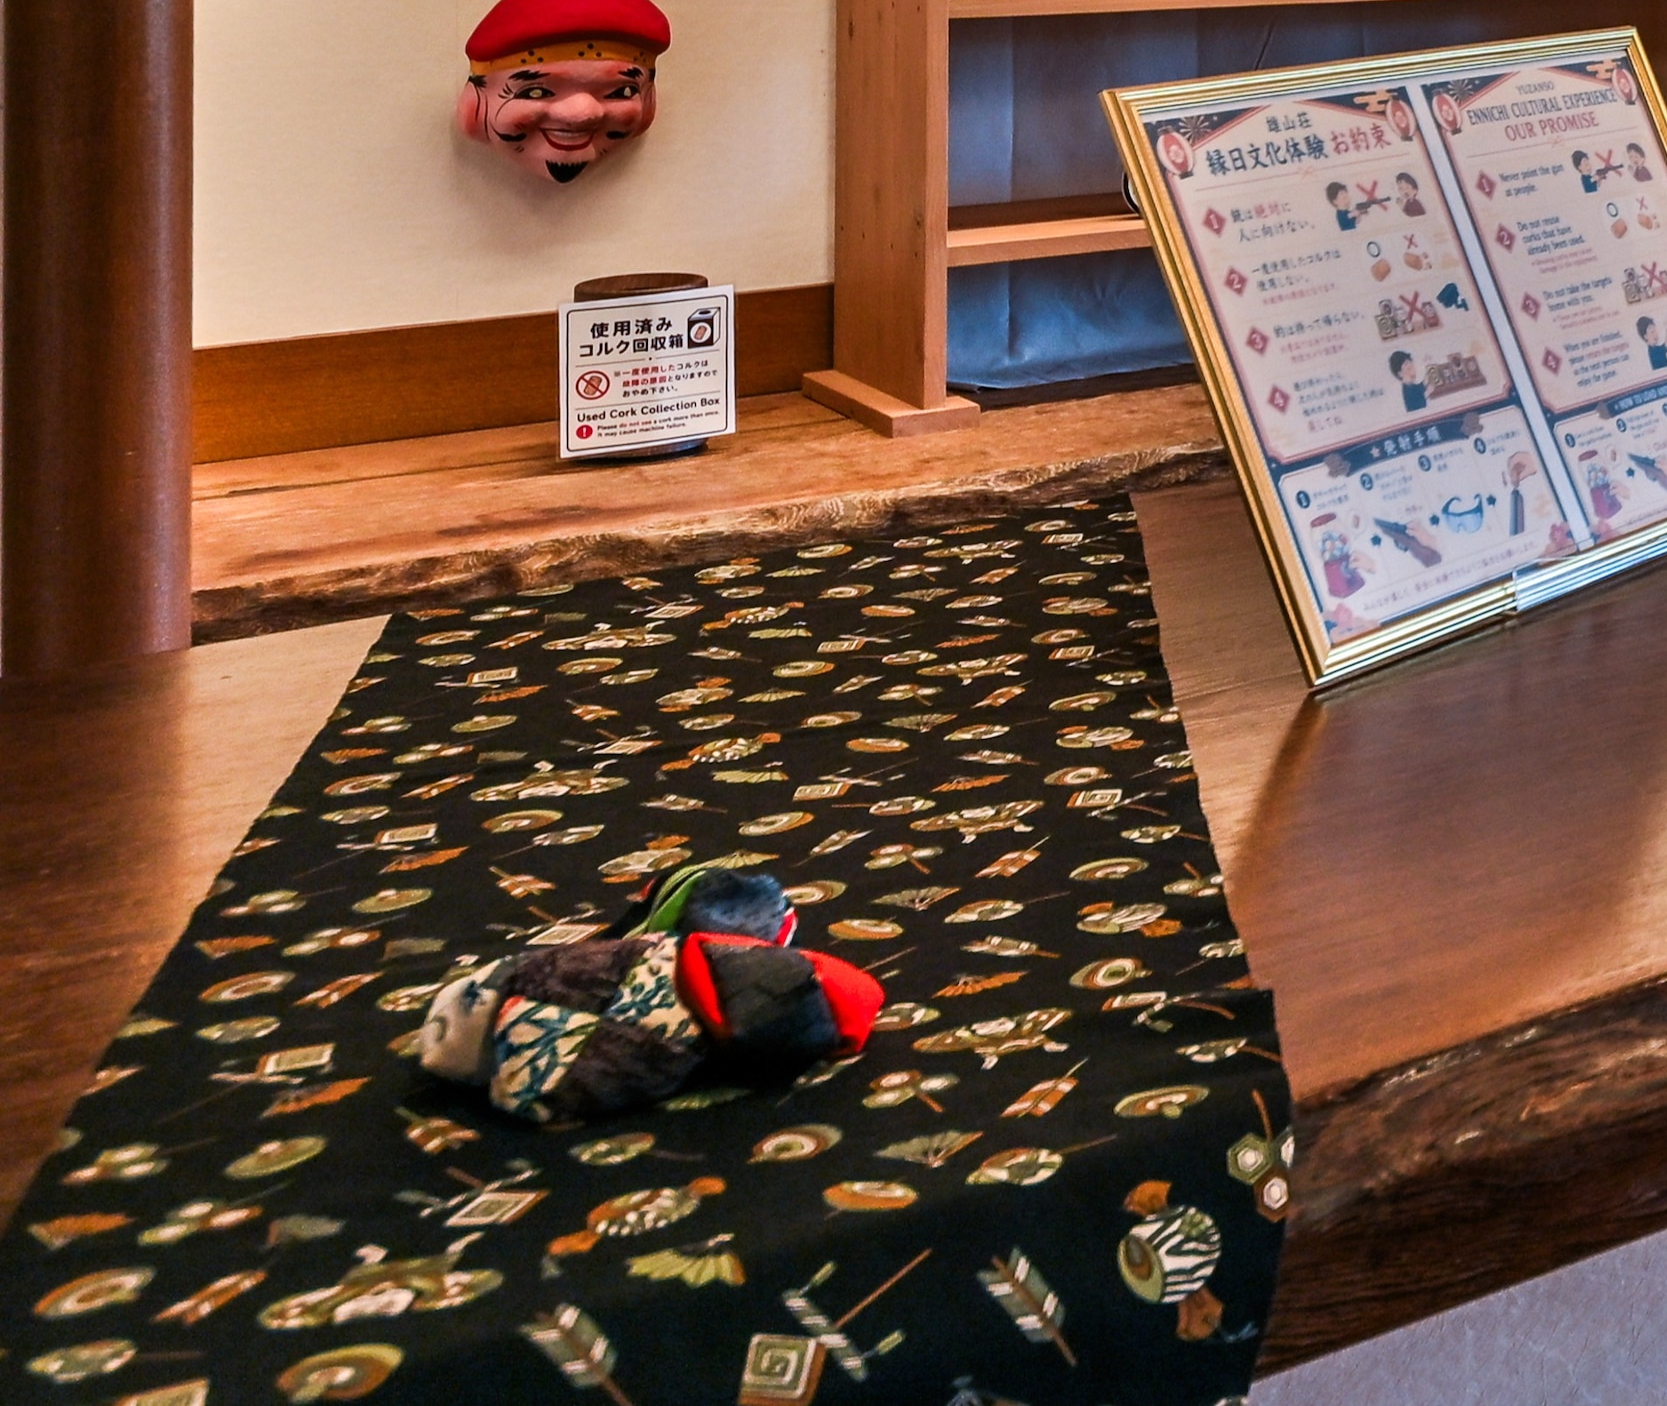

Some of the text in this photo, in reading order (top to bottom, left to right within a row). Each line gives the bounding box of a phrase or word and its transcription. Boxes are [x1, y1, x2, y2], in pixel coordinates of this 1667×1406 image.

[1466, 87, 1618, 127] ENNICHI CULTURAL EXPERIENCE
[1265, 111, 1313, 134] 雄山荘
[1504, 111, 1599, 142] OUR PROMISE
[1205, 122, 1392, 177] 縁日文化体験 お約束
[590, 317, 673, 340] 使用済み
[579, 333, 684, 358] コルク回収箱
[577, 397, 720, 423] Used Cork Collection Box
